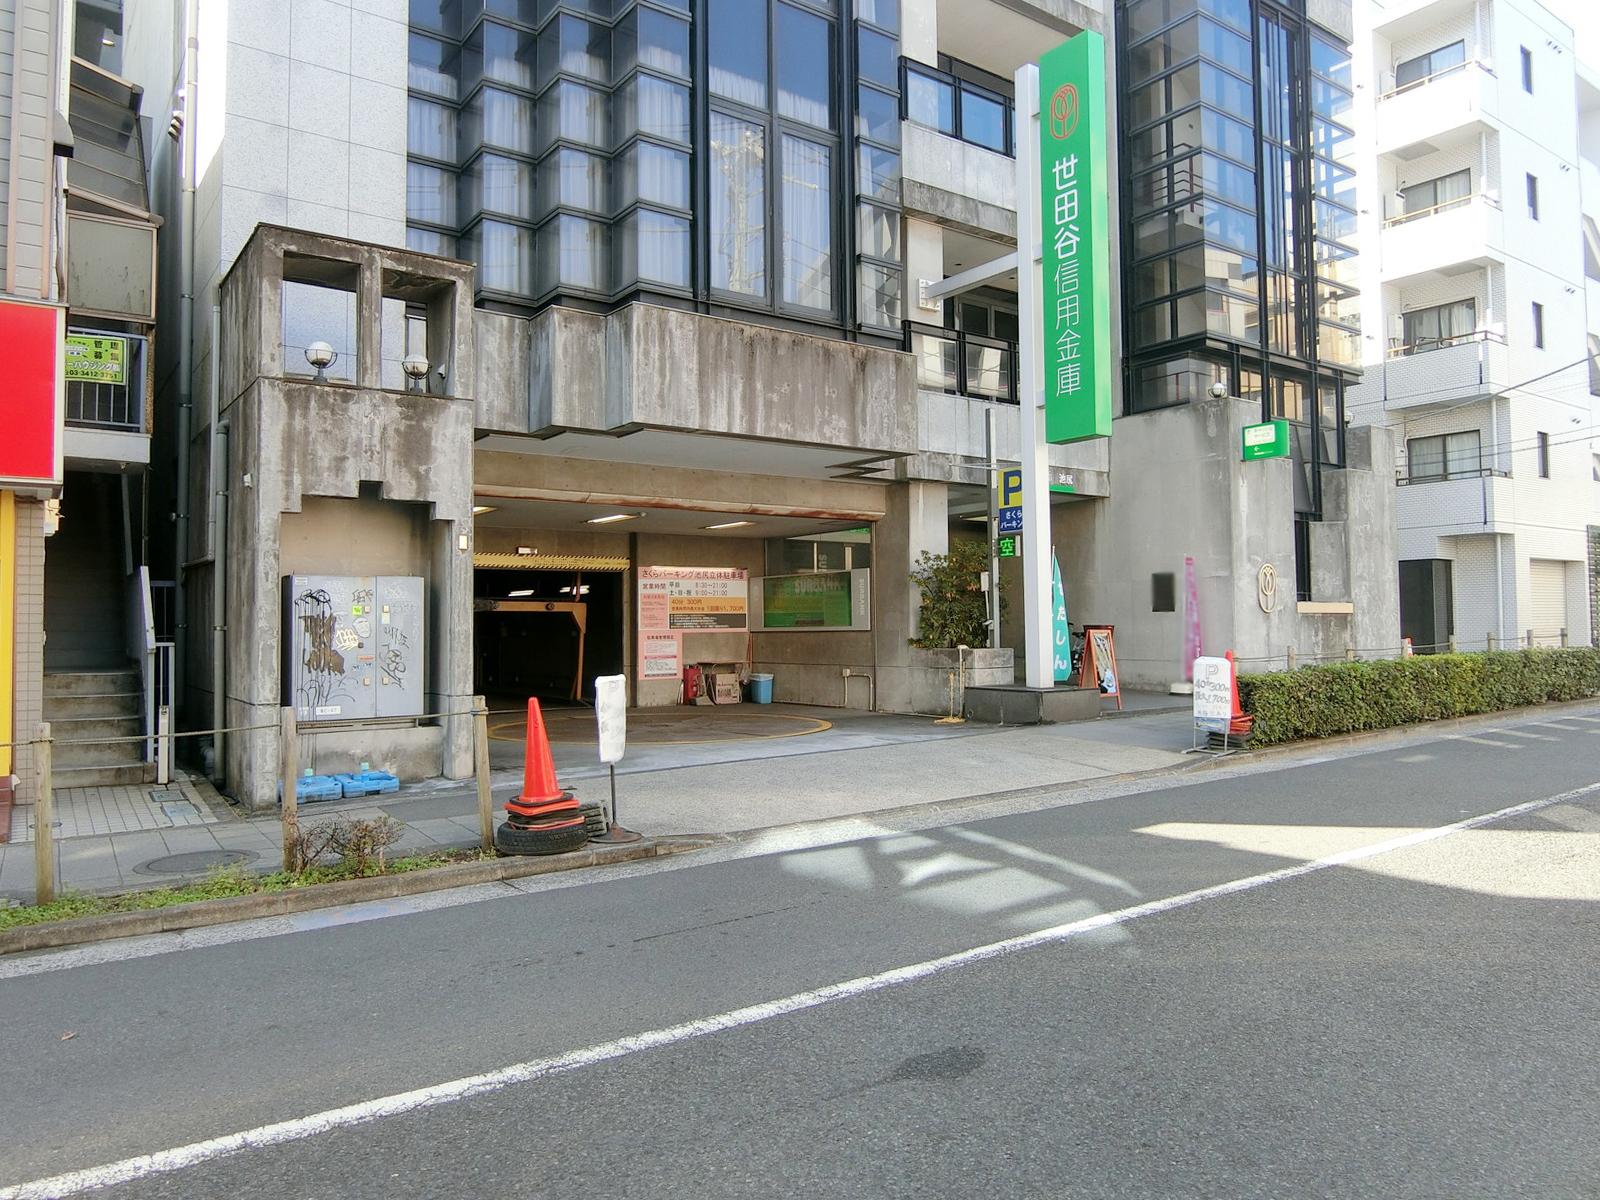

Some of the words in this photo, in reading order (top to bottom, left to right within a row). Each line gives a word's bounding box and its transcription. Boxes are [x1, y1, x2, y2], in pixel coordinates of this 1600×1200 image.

[1052, 154, 1081, 396] 世田谷信用金庫
[1003, 469, 1022, 506] P
[1005, 510, 1022, 520] さくら
[1000, 537, 1014, 557] 空
[642, 569, 744, 579] さくらパーキング池尻立体駐車場
[1205, 664, 1218, 680] P
